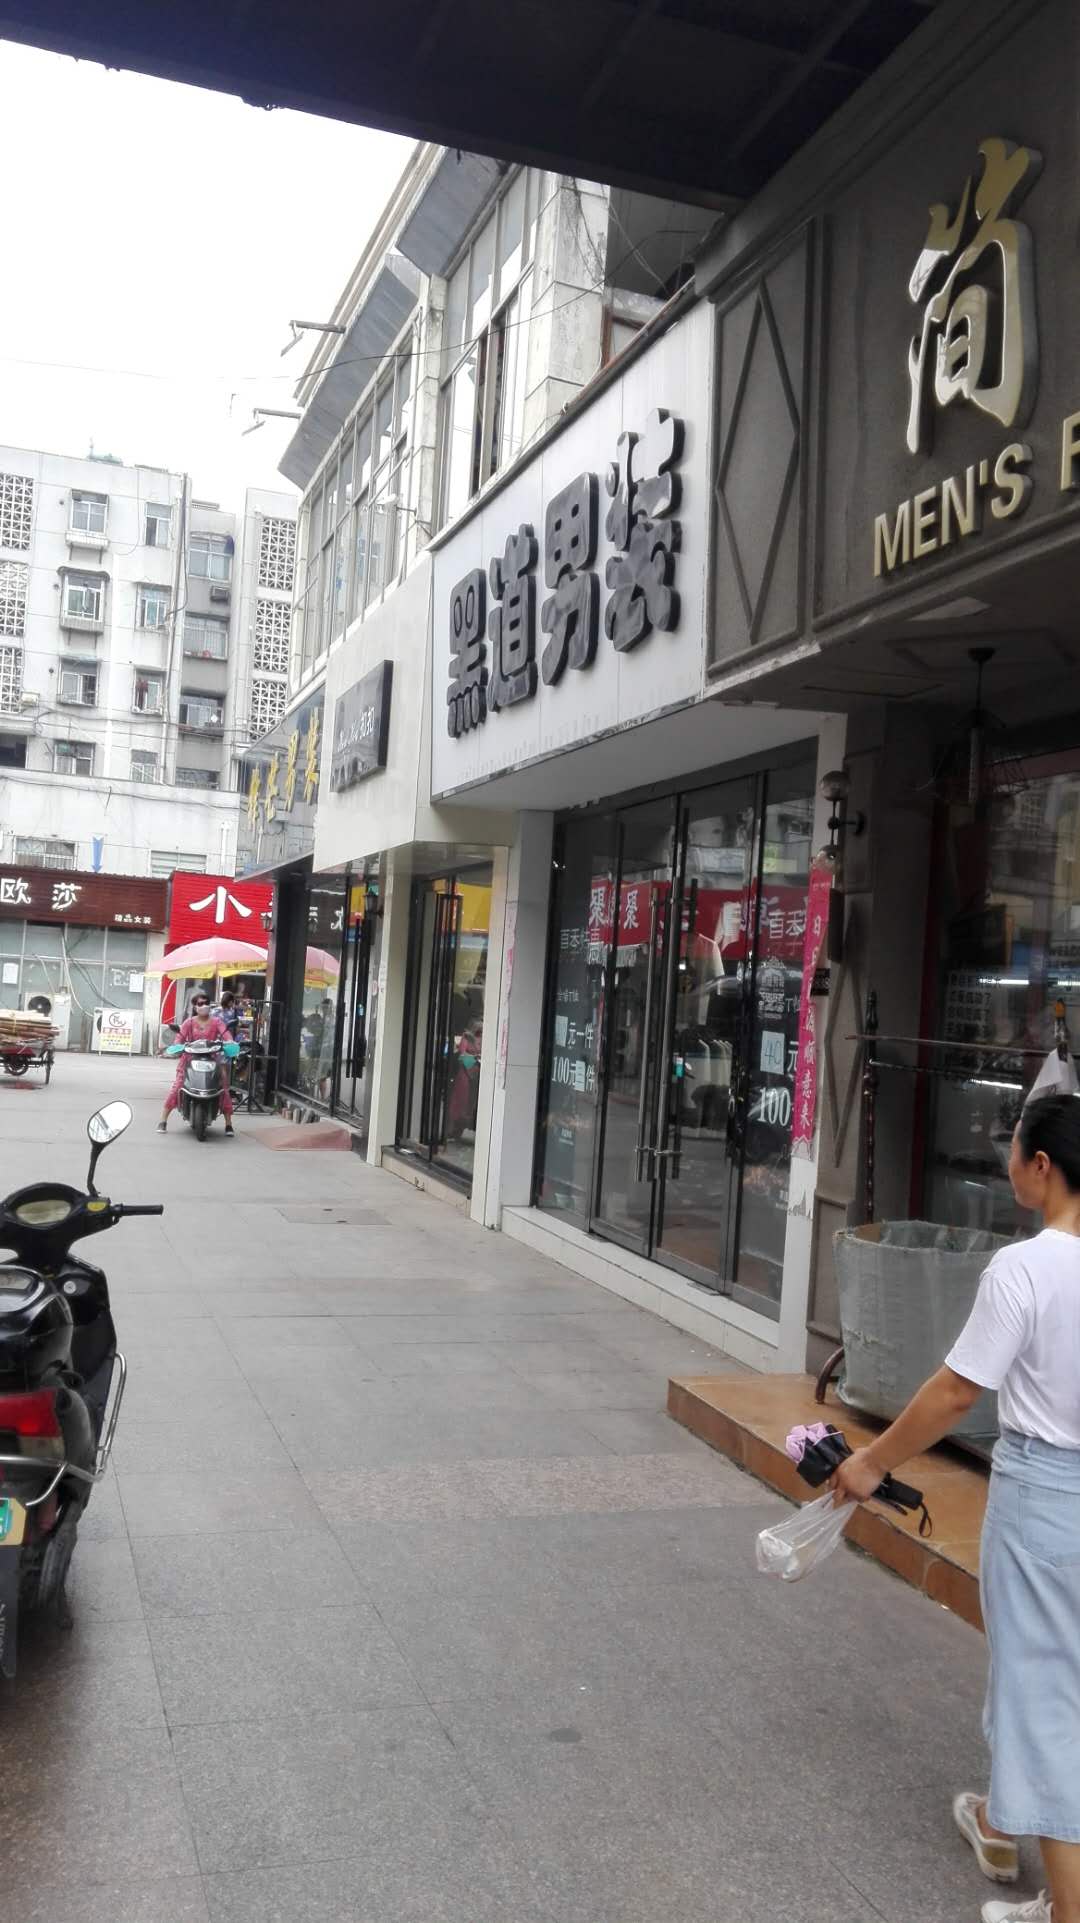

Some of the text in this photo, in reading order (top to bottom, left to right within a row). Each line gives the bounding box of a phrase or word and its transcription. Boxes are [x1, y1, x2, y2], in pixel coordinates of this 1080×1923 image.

[906, 137, 1042, 458] 尚
[447, 408, 685, 739] 黑道男装
[873, 442, 1032, 578] MEN'S
[0, 877, 82, 911] 欧莎
[189, 886, 273, 923] 小
